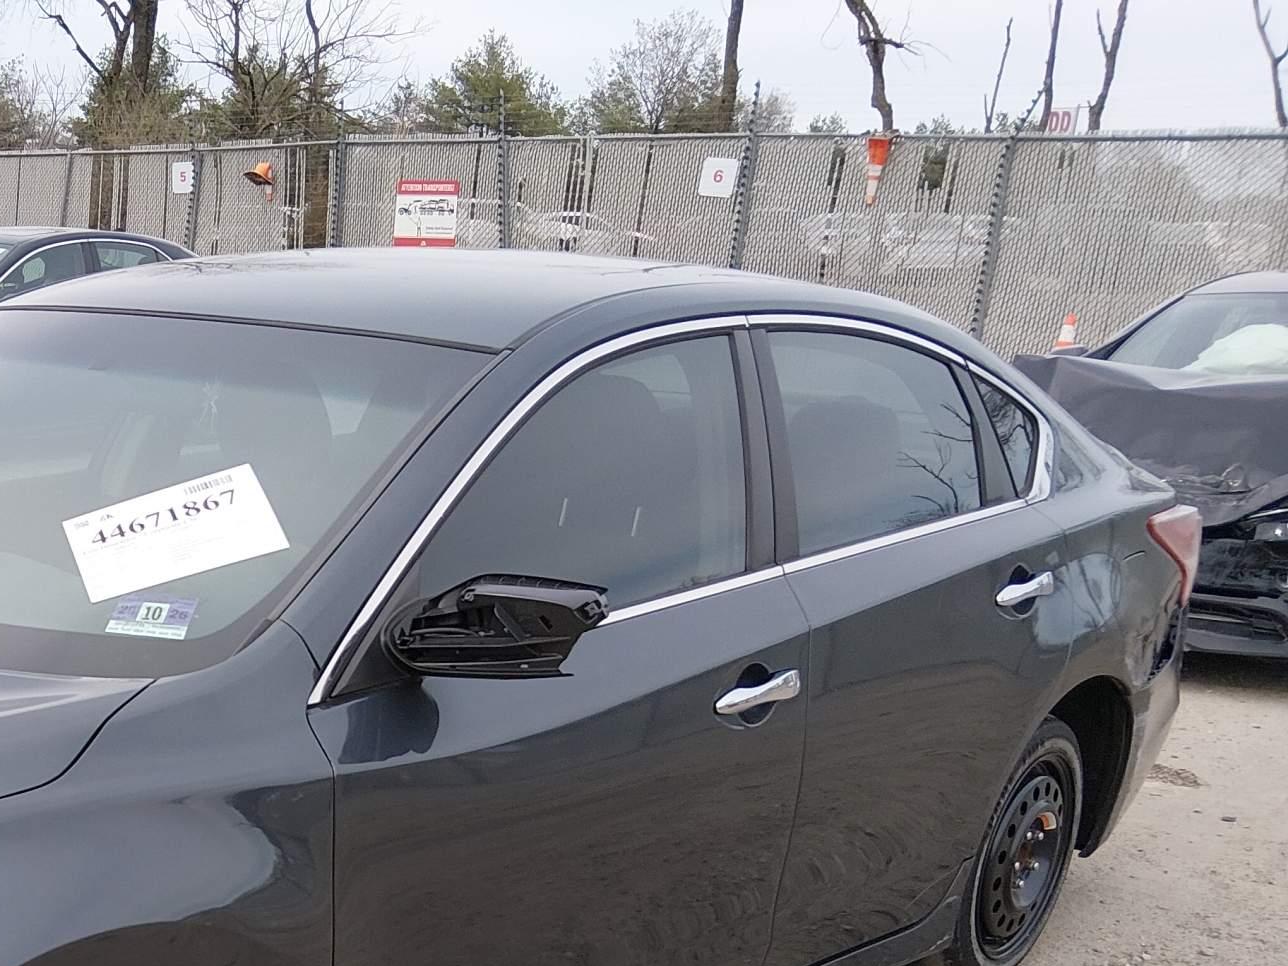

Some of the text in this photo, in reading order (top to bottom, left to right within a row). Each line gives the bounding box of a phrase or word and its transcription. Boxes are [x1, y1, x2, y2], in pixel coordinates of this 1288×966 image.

[179, 171, 187, 183] 5
[713, 170, 724, 183] 6
[91, 489, 235, 544] 44671867
[142, 606, 163, 621] 10
